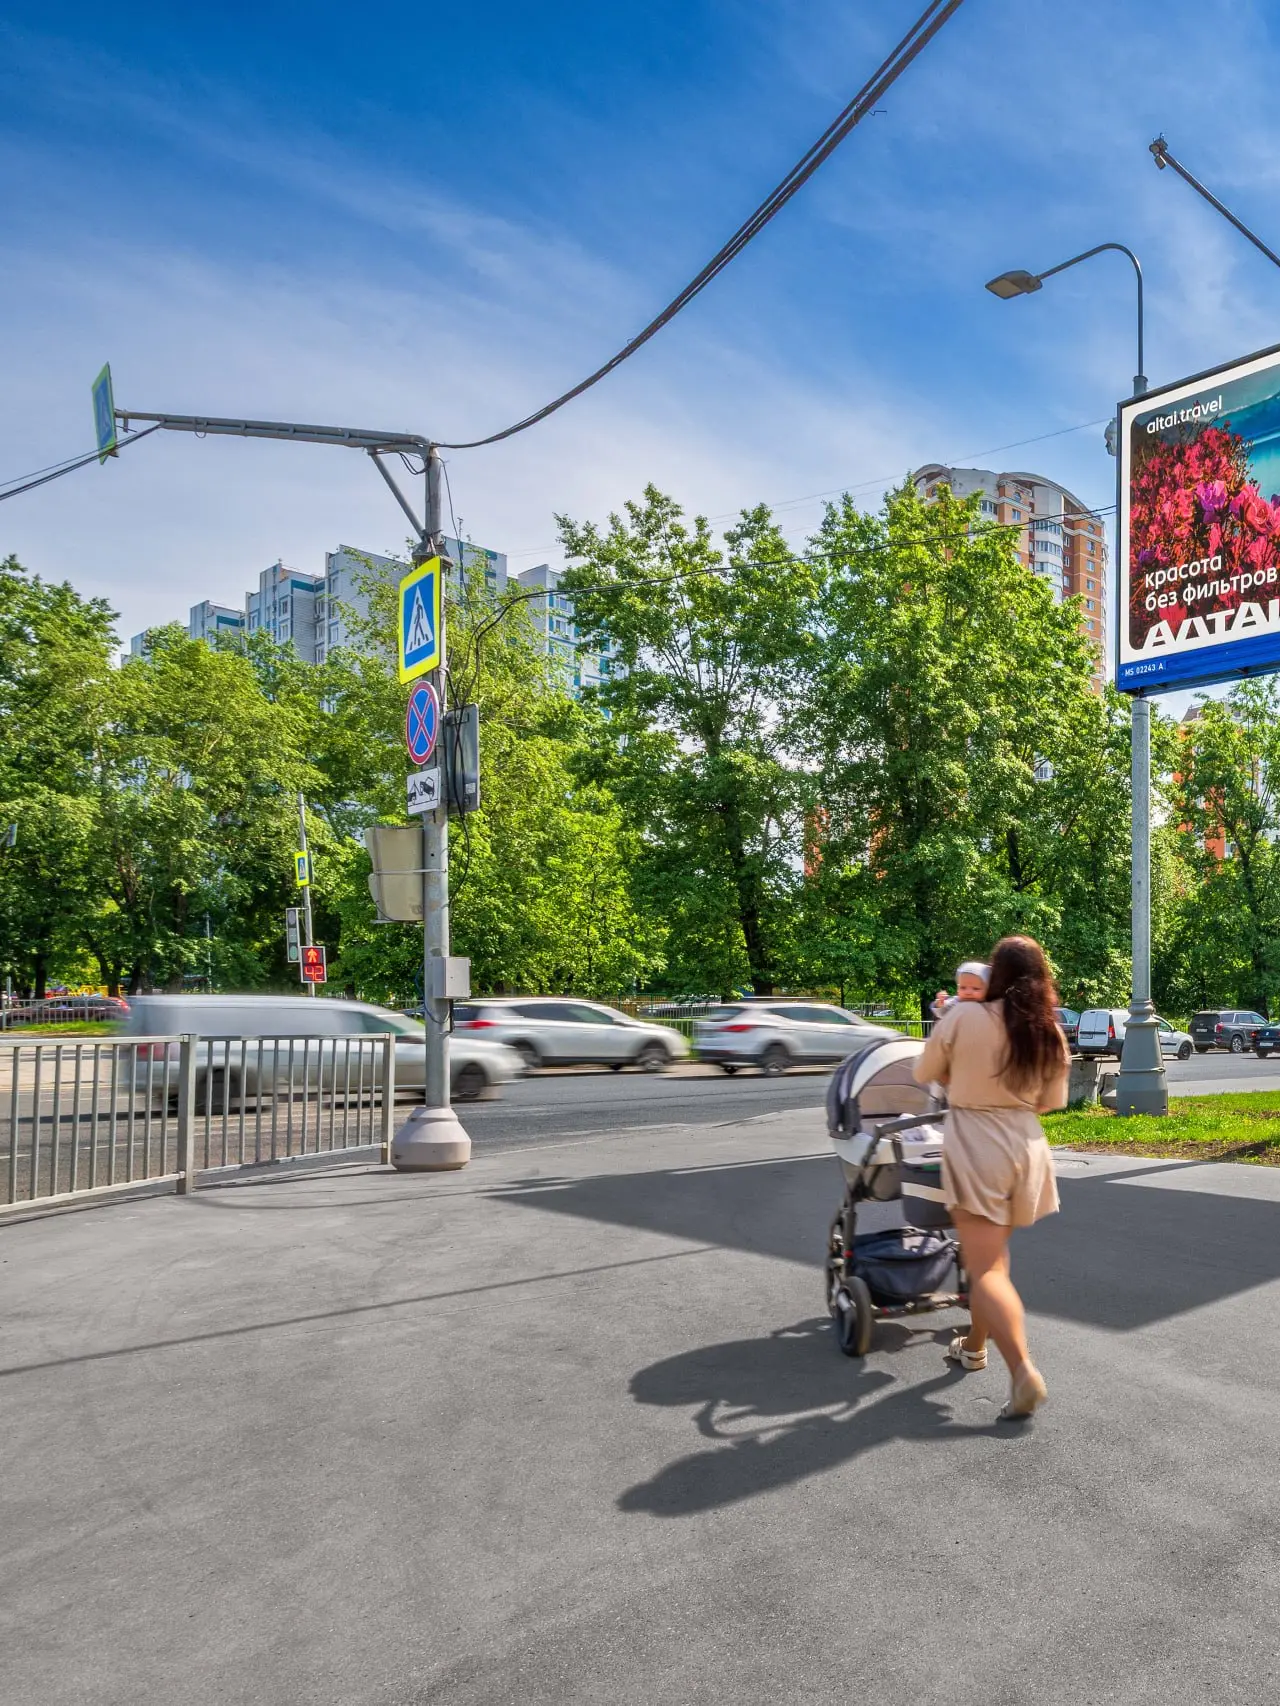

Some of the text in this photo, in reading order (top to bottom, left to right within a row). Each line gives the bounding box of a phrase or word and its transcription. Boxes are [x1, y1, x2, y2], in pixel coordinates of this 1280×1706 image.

[1147, 395, 1222, 433] altai.travel
[1145, 555, 1222, 589] красота
[1145, 566, 1278, 611] без фильтров
[304, 965, 324, 981] 42
